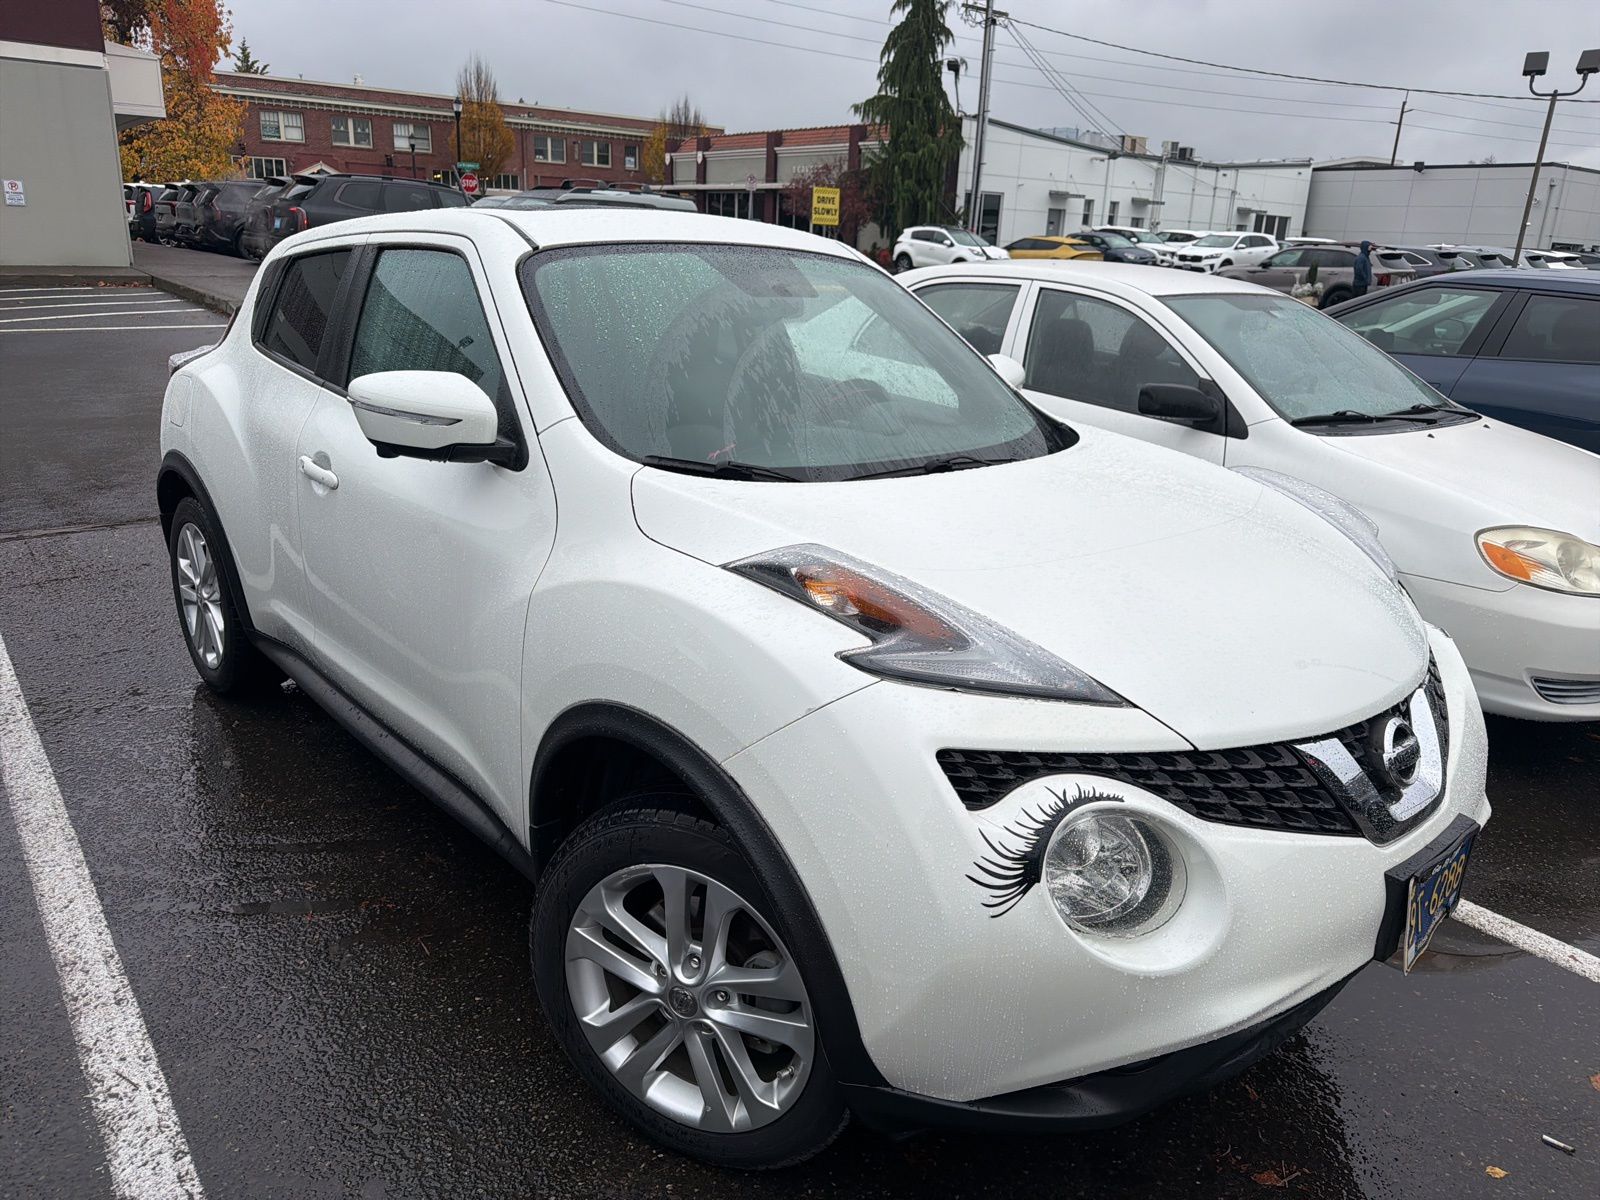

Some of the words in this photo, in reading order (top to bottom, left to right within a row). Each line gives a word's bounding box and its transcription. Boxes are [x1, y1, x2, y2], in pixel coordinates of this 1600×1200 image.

[462, 179, 477, 187] STOP
[816, 196, 836, 205] DRIVE
[813, 207, 838, 216] SLOWLY
